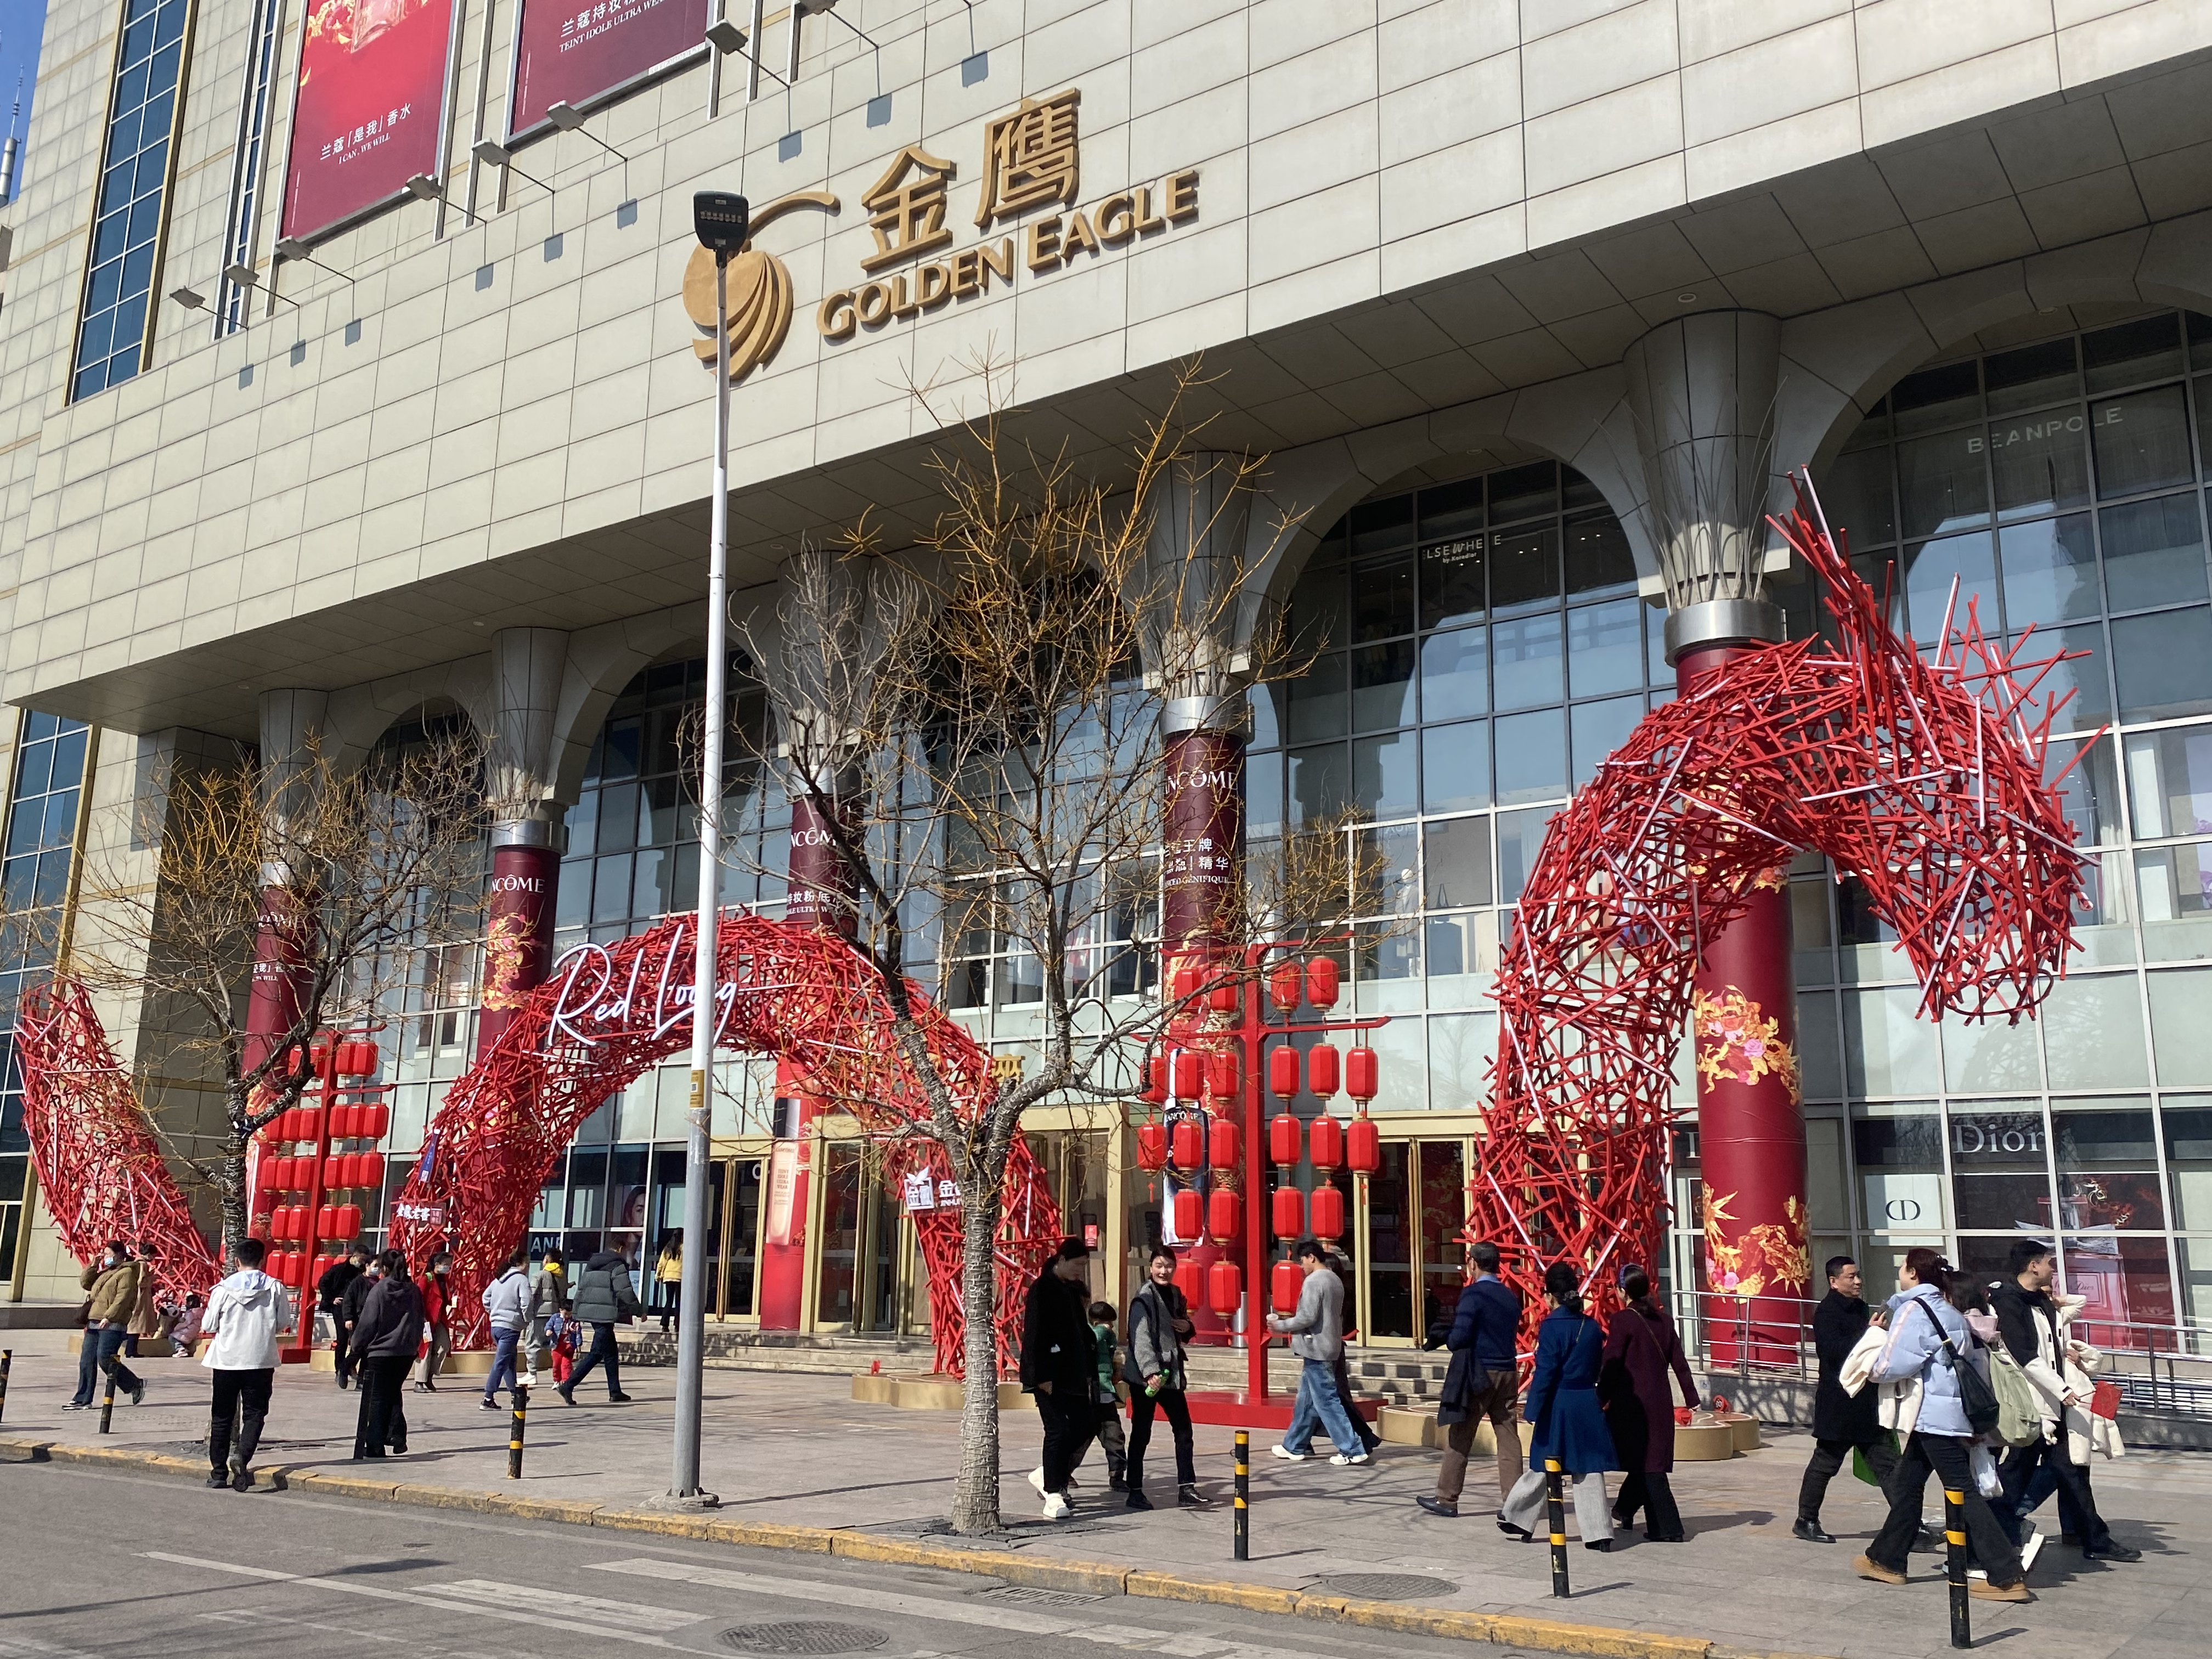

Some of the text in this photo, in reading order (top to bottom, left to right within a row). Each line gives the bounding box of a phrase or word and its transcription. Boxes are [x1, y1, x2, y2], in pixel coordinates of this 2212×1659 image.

[559, 33, 585, 53] TEINT
[586, 20, 613, 40] IDOLE
[614, 5, 642, 26] ULTRA
[360, 141, 373, 153] WE
[373, 132, 391, 147] WILL
[859, 87, 1082, 272] 金鹰
[816, 169, 1200, 339] GOLDEN EAGLE
[549, 943, 645, 1046] Red
[1953, 1124, 2045, 1153] Dior
